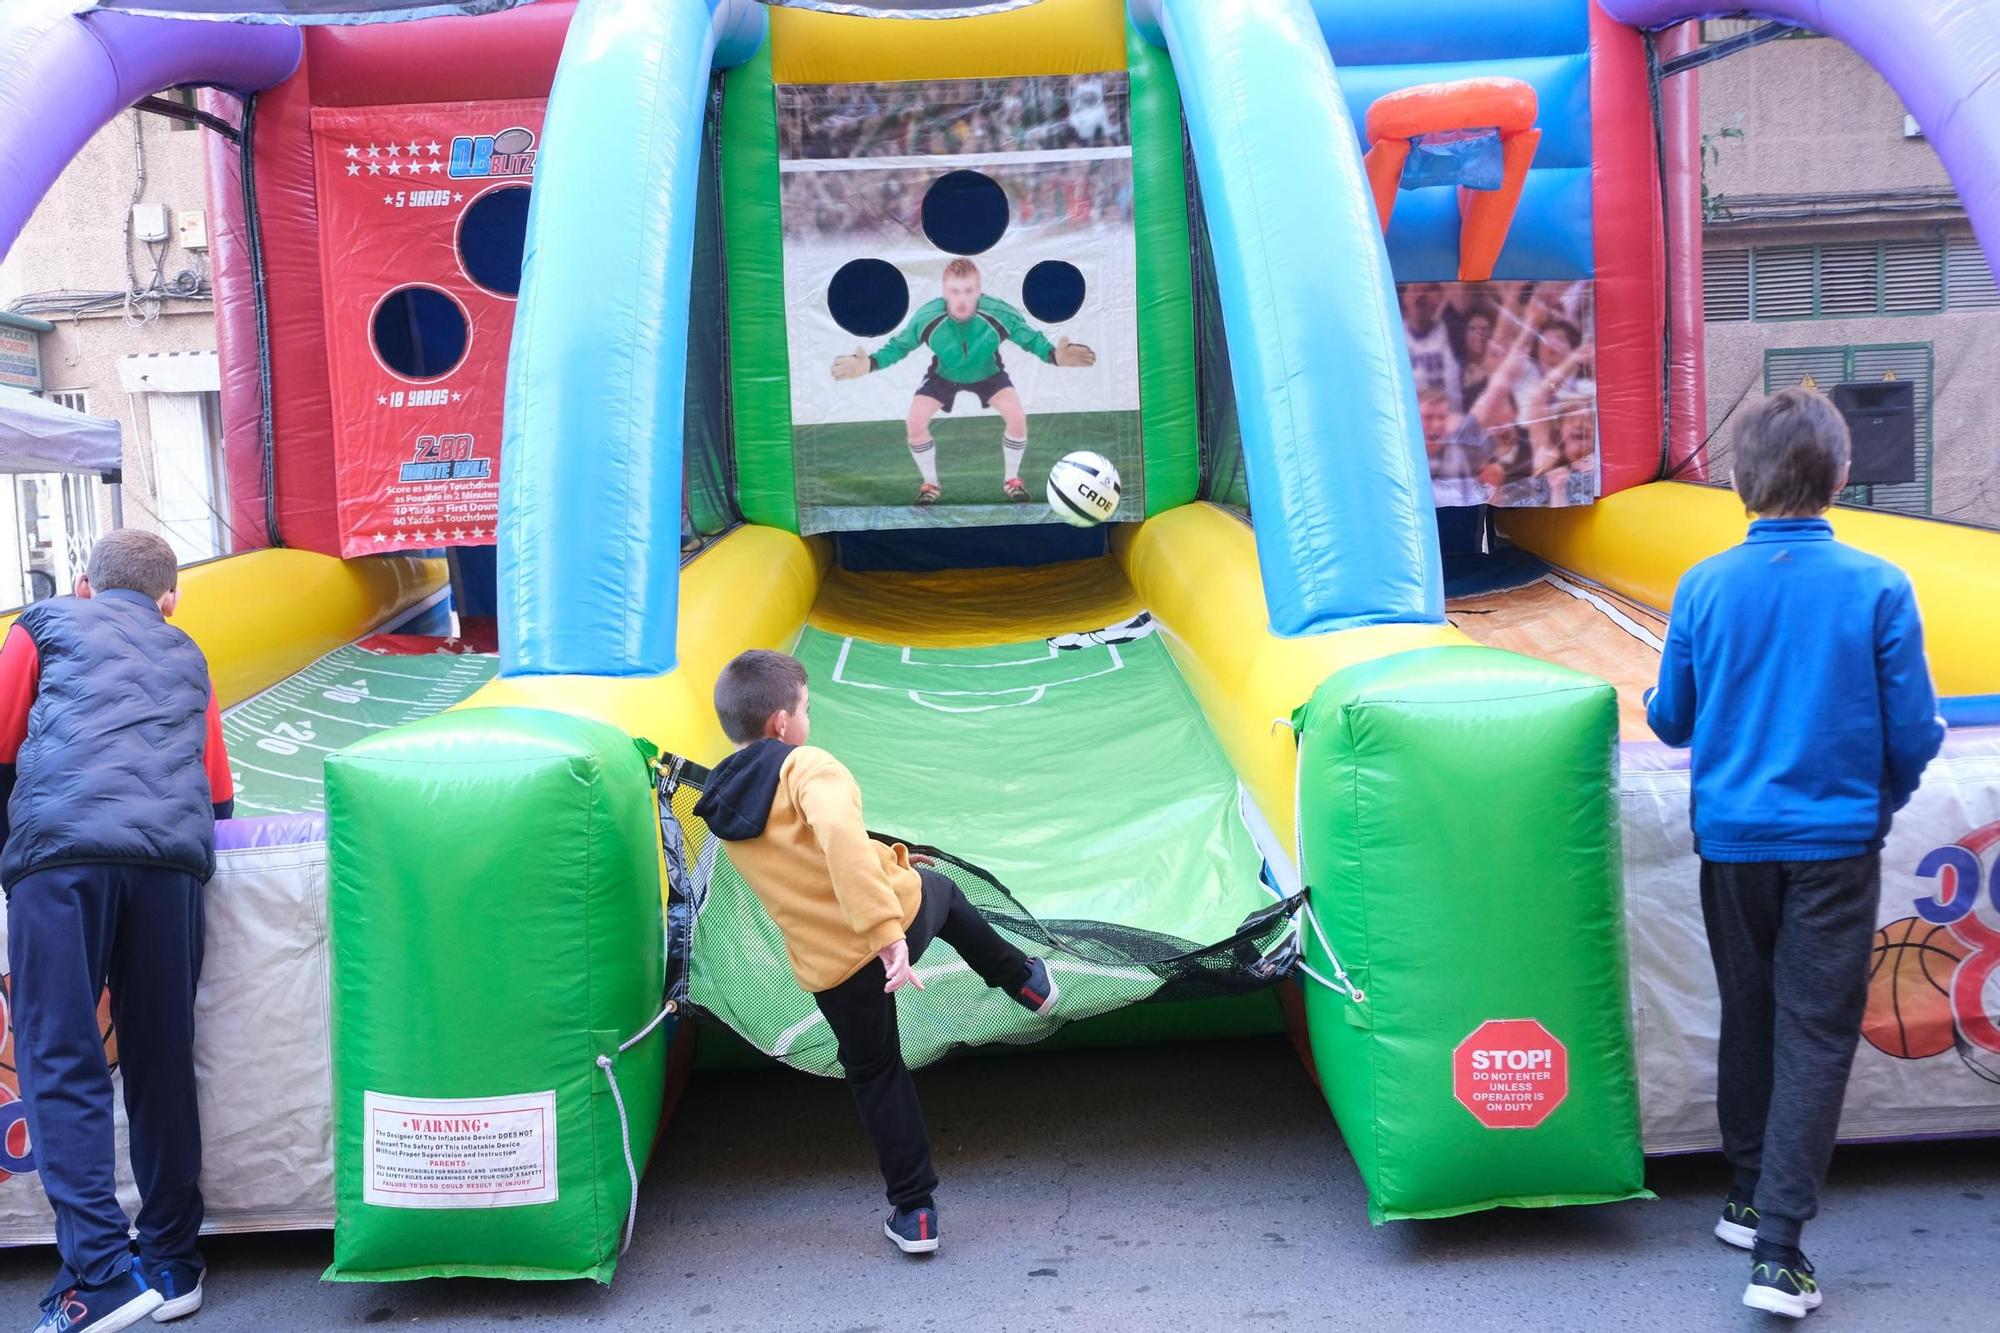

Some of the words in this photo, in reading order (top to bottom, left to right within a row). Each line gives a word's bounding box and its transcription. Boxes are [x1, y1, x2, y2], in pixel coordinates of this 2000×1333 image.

[490, 153, 535, 176] BLITZ
[395, 192, 405, 208] 5
[408, 190, 451, 208] YARDS
[407, 389, 449, 407] YARDS
[386, 485, 411, 495] Score
[424, 483, 448, 494] Many
[395, 495, 405, 503] as
[406, 493, 442, 503] Possible
[453, 492, 460, 500] 2
[461, 491, 497, 500] Minutes
[395, 507, 406, 516] 10
[407, 505, 435, 516] Yards
[446, 504, 468, 513] First
[393, 517, 405, 526] 60
[407, 516, 435, 525] Yards
[1471, 1049, 1552, 1070] STOP!
[1472, 1072, 1489, 1081] DO
[1490, 1072, 1514, 1081] NOT
[1516, 1071, 1551, 1081] ENTER
[1489, 1082, 1533, 1092] UNLESS
[1472, 1092, 1532, 1101] OPERATOR
[1533, 1092, 1544, 1101] IS
[1486, 1103, 1502, 1112] ON
[1504, 1103, 1533, 1112] DUTY
[411, 1118, 481, 1133] WARNING
[376, 1129, 386, 1137] The
[386, 1131, 414, 1141] Designer
[438, 1134, 471, 1142] Inflatable
[473, 1133, 497, 1141] Device
[498, 1131, 518, 1139] DOES
[376, 1139, 399, 1148] Warrant
[412, 1143, 434, 1152] Safety
[461, 1143, 496, 1151] Inflatable
[496, 1141, 521, 1149] Device
[376, 1147, 398, 1156] Without
[399, 1151, 421, 1159] Proper
[477, 1150, 517, 1158] Instruction
[489, 1163, 538, 1173] UNDERSTANDING
[382, 1180, 406, 1188] FAILURE
[505, 1179, 530, 1187] INJURY
